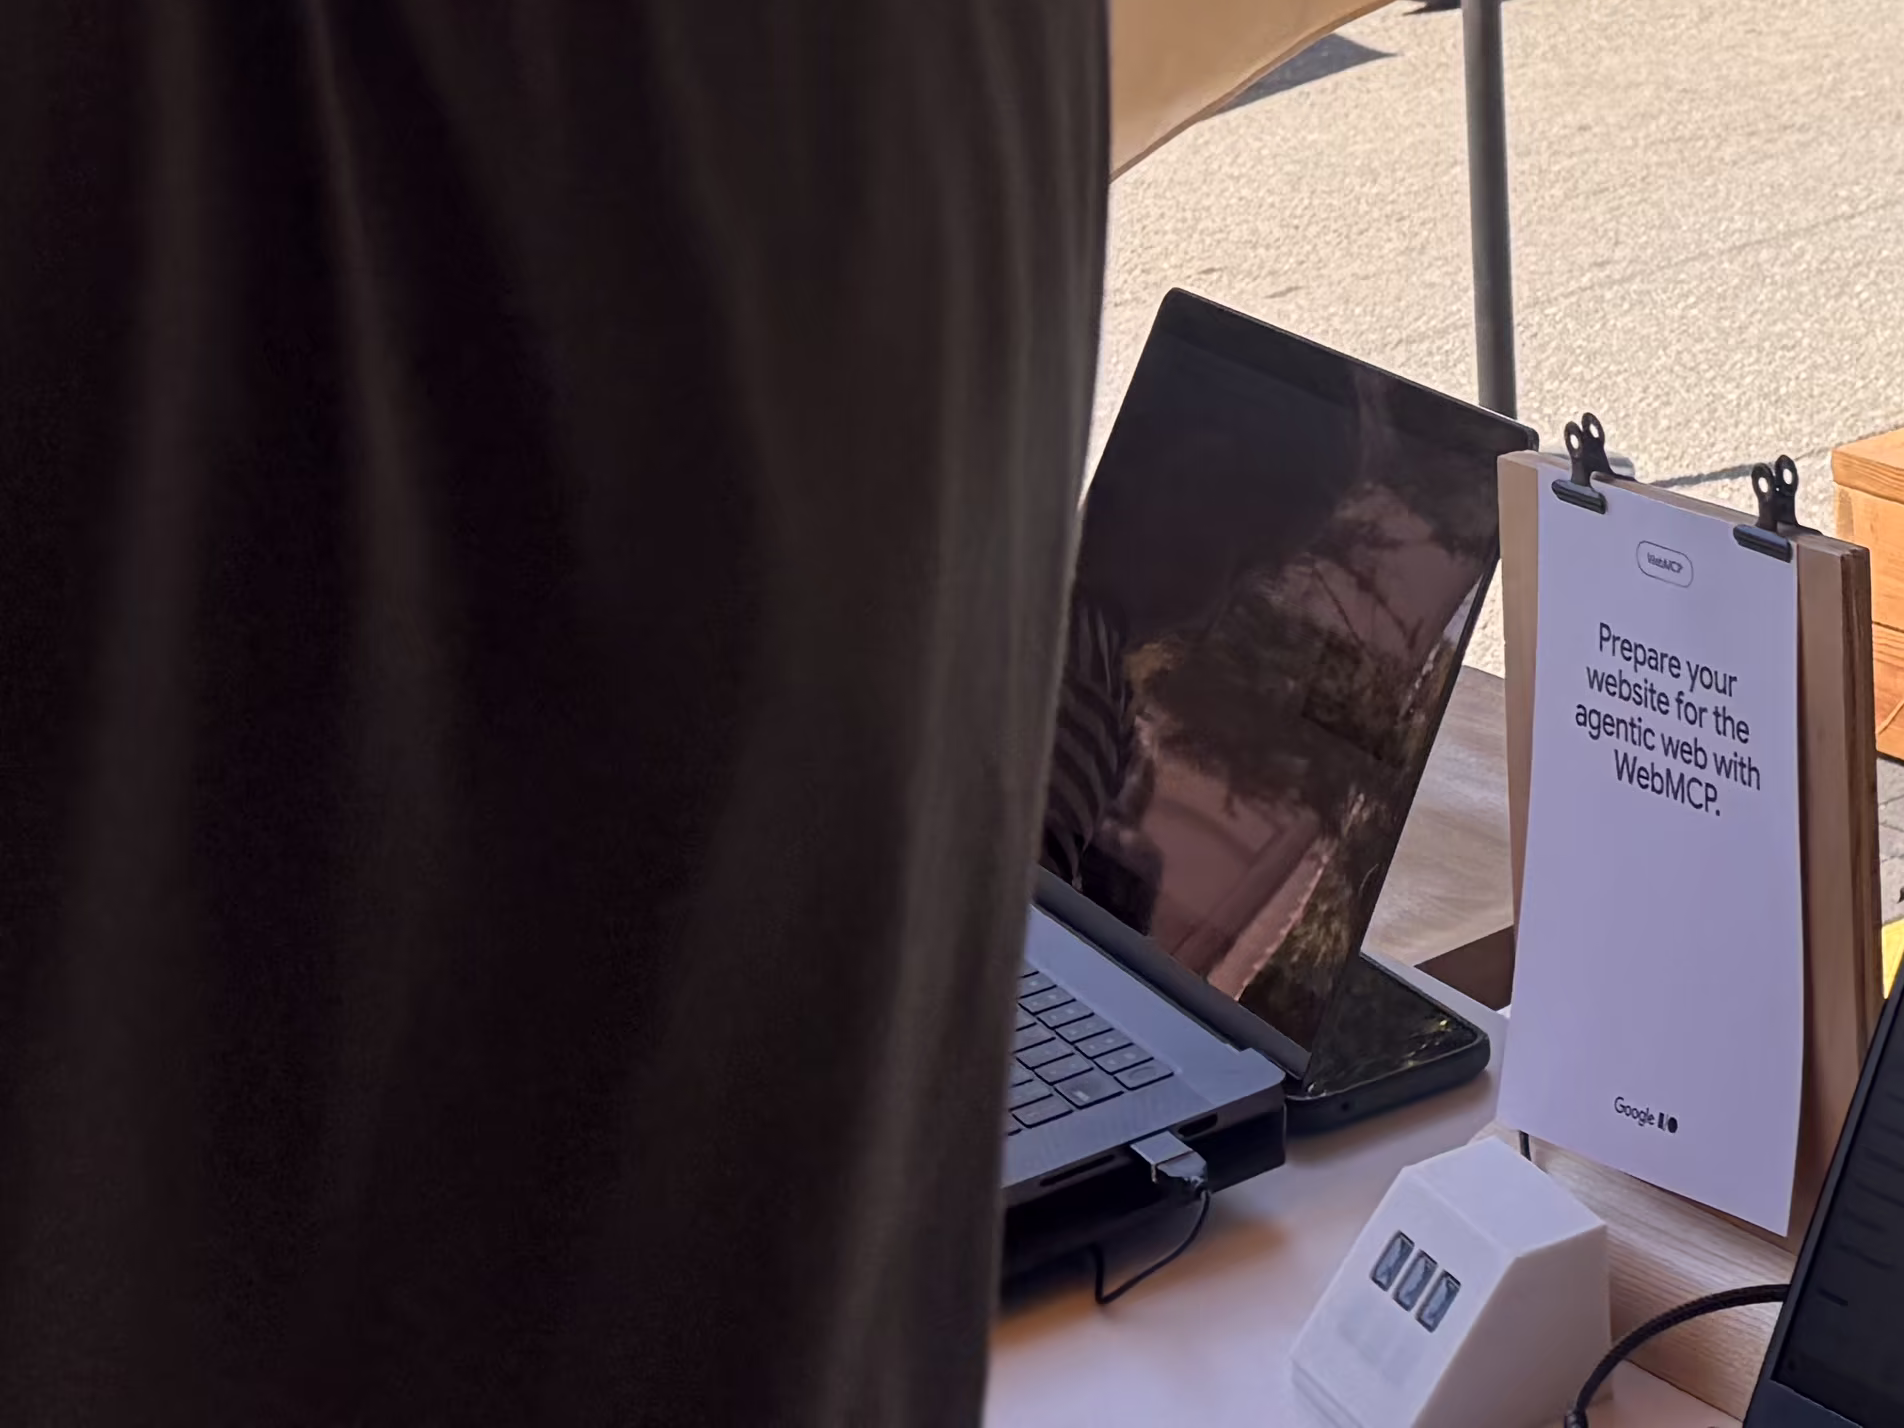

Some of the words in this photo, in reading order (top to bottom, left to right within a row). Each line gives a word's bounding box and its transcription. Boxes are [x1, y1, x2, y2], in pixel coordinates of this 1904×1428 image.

[1599, 622, 1681, 678] Prepare
[1686, 660, 1737, 697] your
[1586, 666, 1670, 715] website
[1675, 691, 1708, 728] for
[1713, 706, 1750, 744] the
[1575, 704, 1655, 751] agentic
[1660, 733, 1708, 770] web
[1713, 751, 1760, 791] with
[1614, 749, 1721, 816] WebMCP.
[1614, 1096, 1655, 1126] Google
